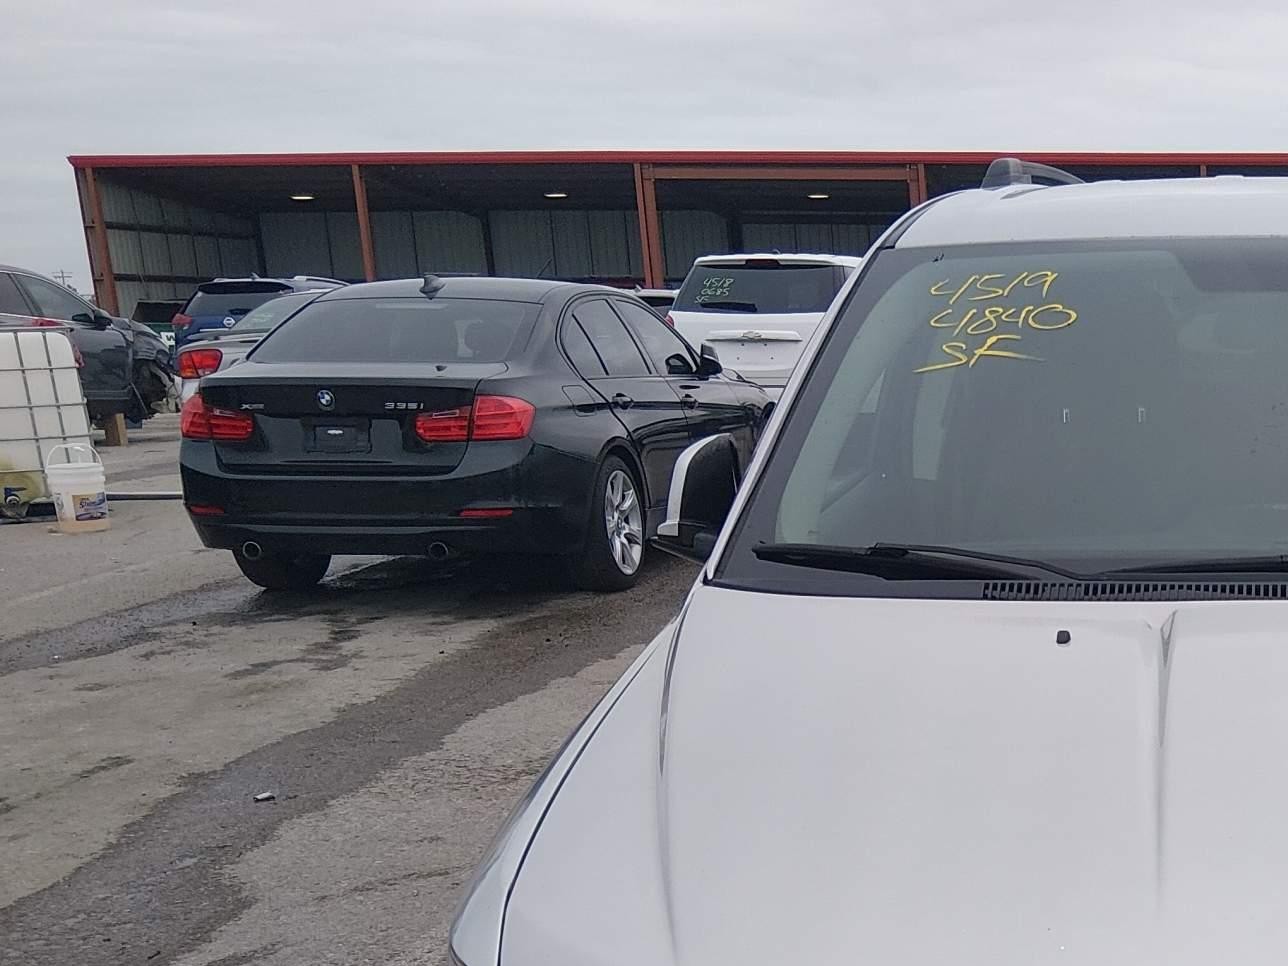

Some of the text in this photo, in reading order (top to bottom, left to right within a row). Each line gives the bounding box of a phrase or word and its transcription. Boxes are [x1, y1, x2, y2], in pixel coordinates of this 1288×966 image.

[930, 271, 1058, 304] 4519
[930, 304, 1077, 336] 4840
[912, 335, 1047, 373] SF
